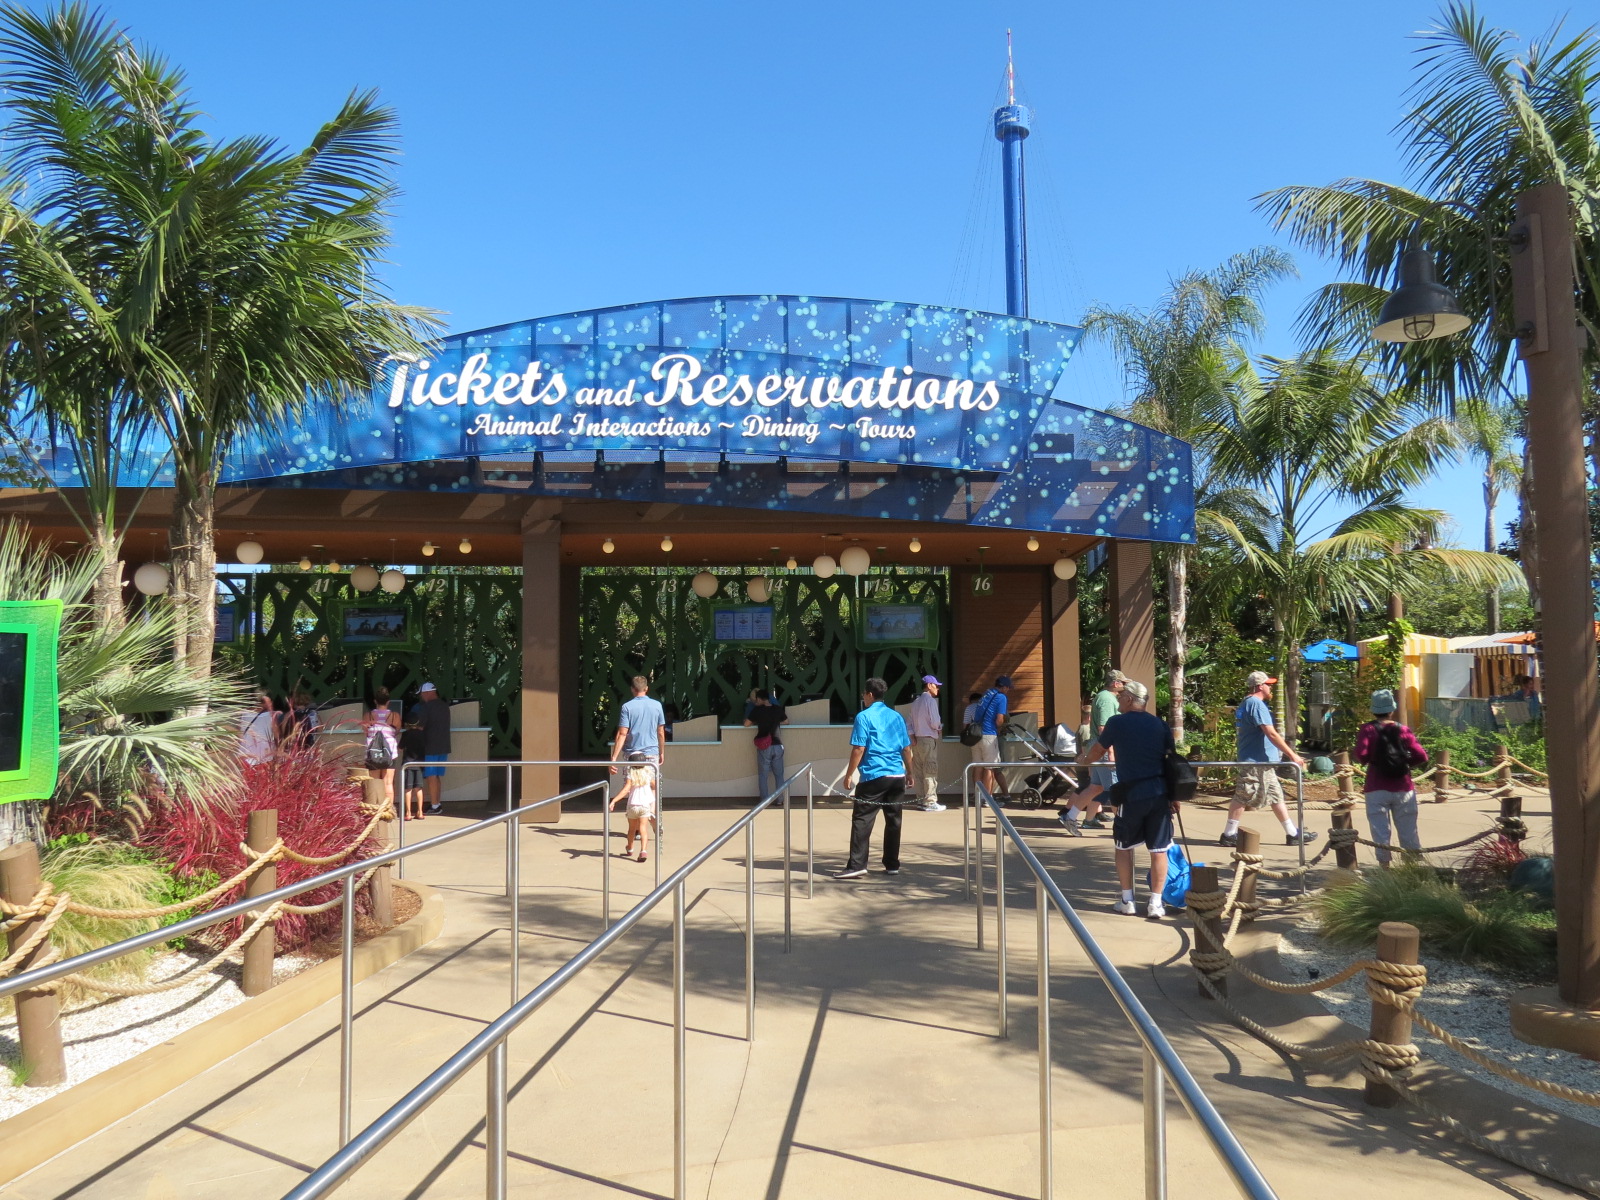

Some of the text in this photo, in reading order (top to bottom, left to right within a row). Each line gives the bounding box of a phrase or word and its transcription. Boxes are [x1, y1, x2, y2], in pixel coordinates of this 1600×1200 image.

[374, 351, 1001, 411] Tickets and Reservations
[467, 413, 563, 436] Animal
[568, 413, 711, 437] Interactions
[742, 414, 820, 444] Dining
[855, 416, 916, 439] Tours
[314, 578, 330, 593] 11
[427, 578, 446, 592] 12
[660, 578, 678, 593] 13
[767, 578, 783, 592] 14
[874, 578, 891, 592] 15
[974, 577, 991, 591] 16
